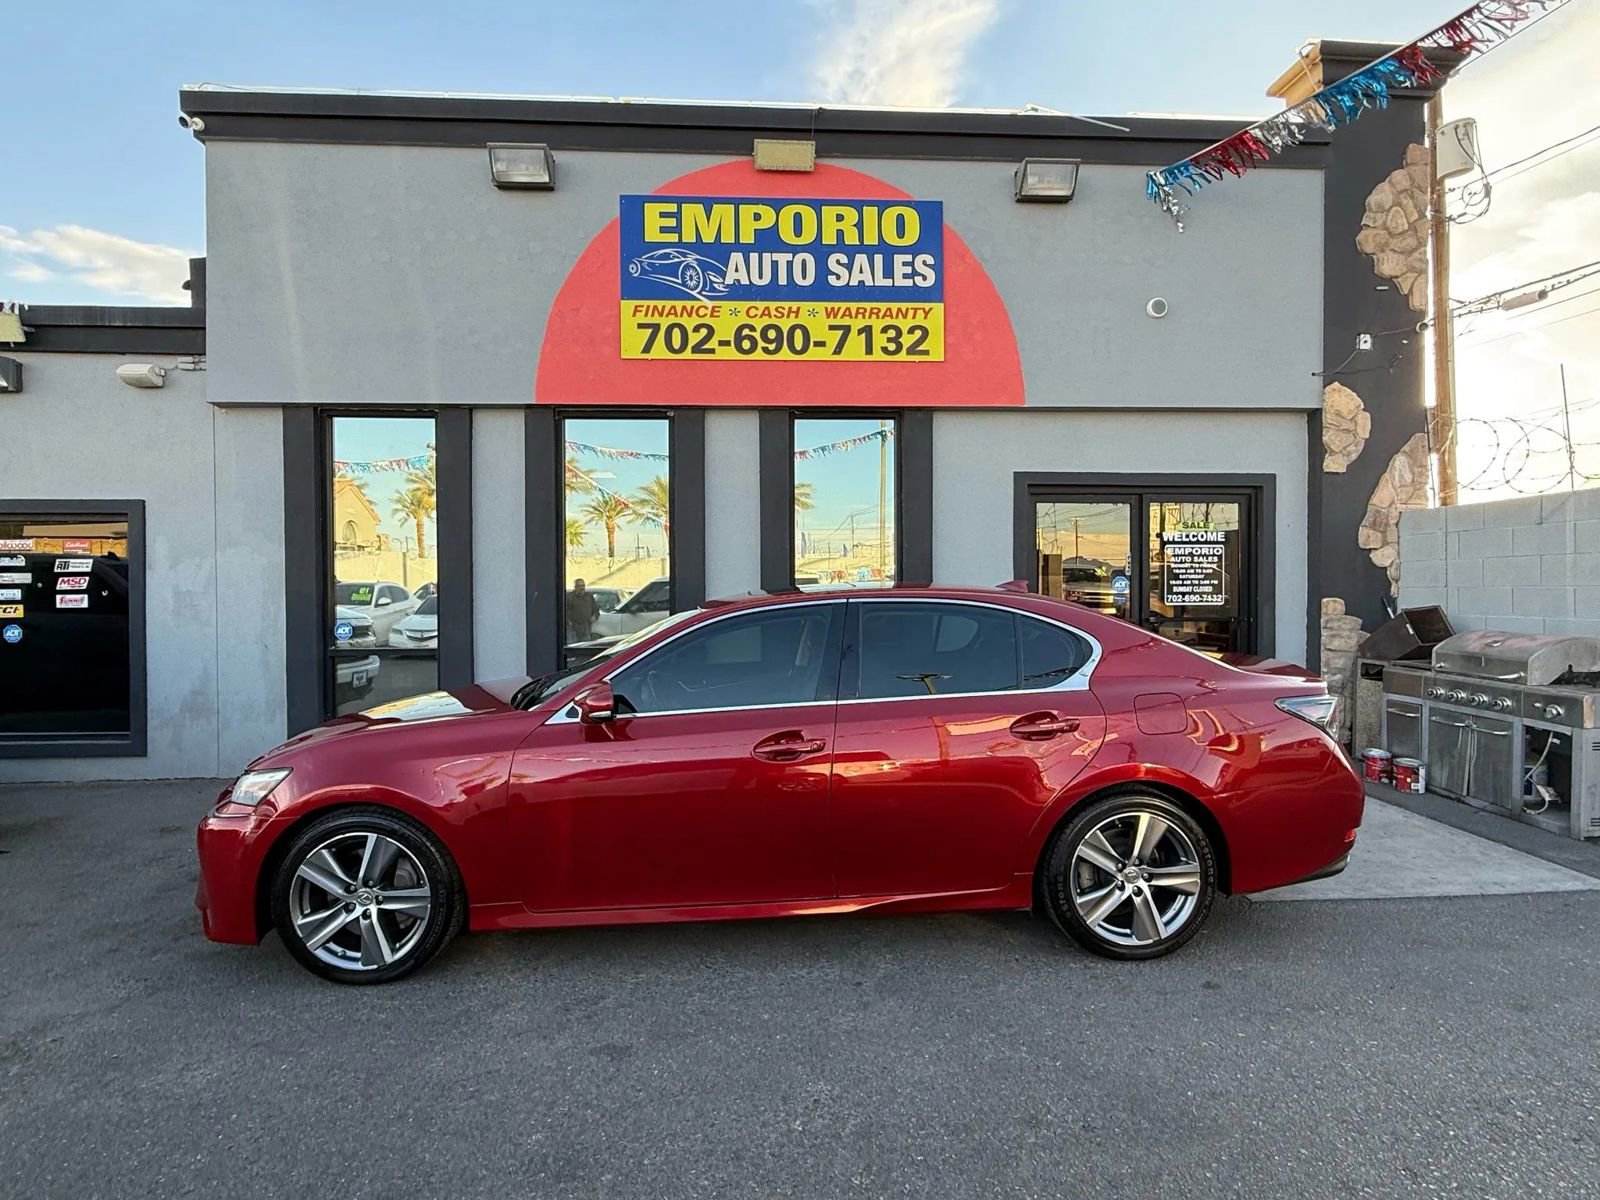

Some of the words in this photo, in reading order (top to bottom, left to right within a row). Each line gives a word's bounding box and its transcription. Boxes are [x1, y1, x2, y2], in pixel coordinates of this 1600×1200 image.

[643, 202, 921, 246] EMPORIO
[724, 252, 816, 287] AUTO
[827, 253, 936, 288] SALES
[631, 304, 723, 319] FINANCE
[745, 305, 801, 320] CASH
[823, 306, 934, 320] WARRANTY
[636, 322, 931, 357] 702-690-7132
[1182, 521, 1210, 529] SALE
[1162, 532, 1225, 541] WELCOME
[1167, 547, 1222, 555] EMPORIO
[60, 577, 87, 586] MSD
